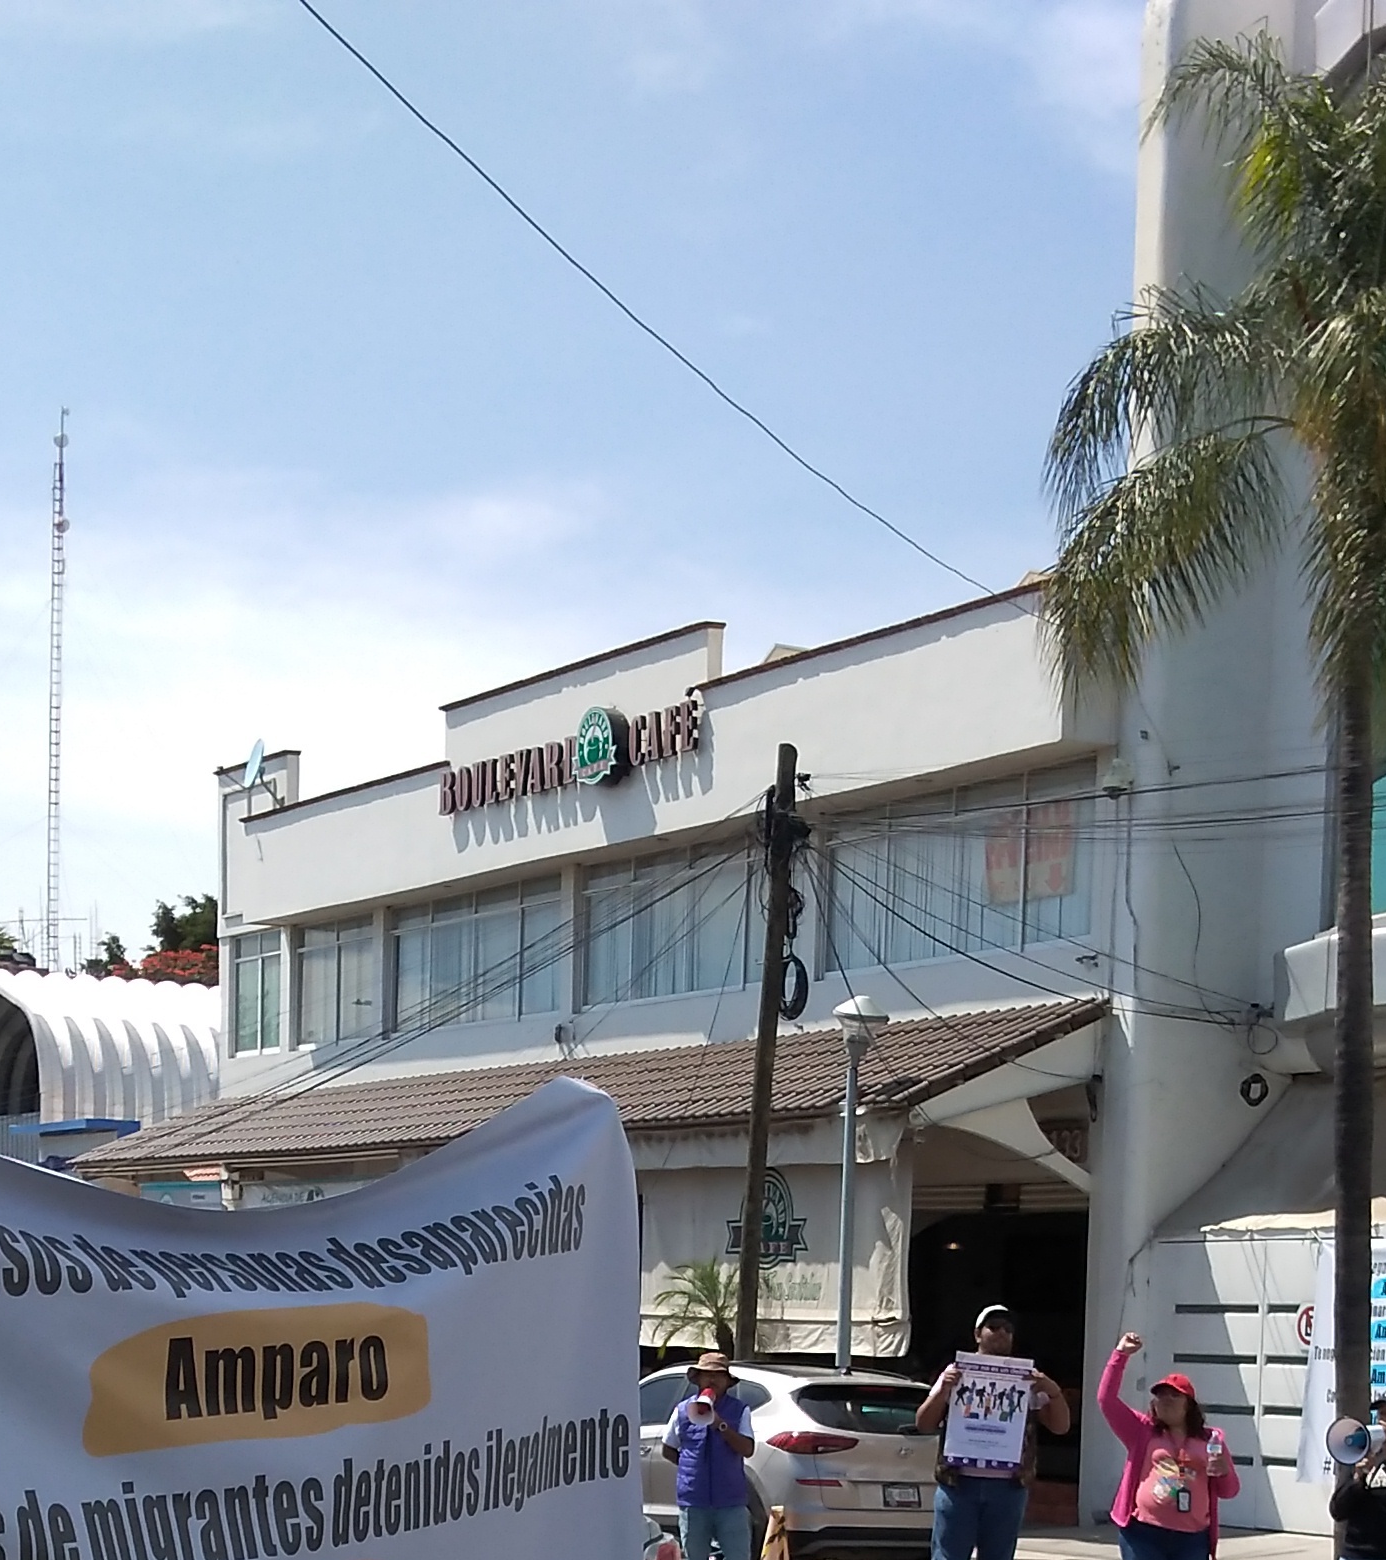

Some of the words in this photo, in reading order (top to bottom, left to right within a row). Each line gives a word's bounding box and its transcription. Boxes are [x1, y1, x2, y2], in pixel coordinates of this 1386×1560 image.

[73, 1234, 156, 1292] de
[129, 1249, 354, 1298] personas
[327, 1175, 586, 1289] desaparecidas
[165, 1334, 390, 1421] Amparo
[332, 1442, 481, 1548] detenidos
[482, 1407, 630, 1513] ilegalmente
